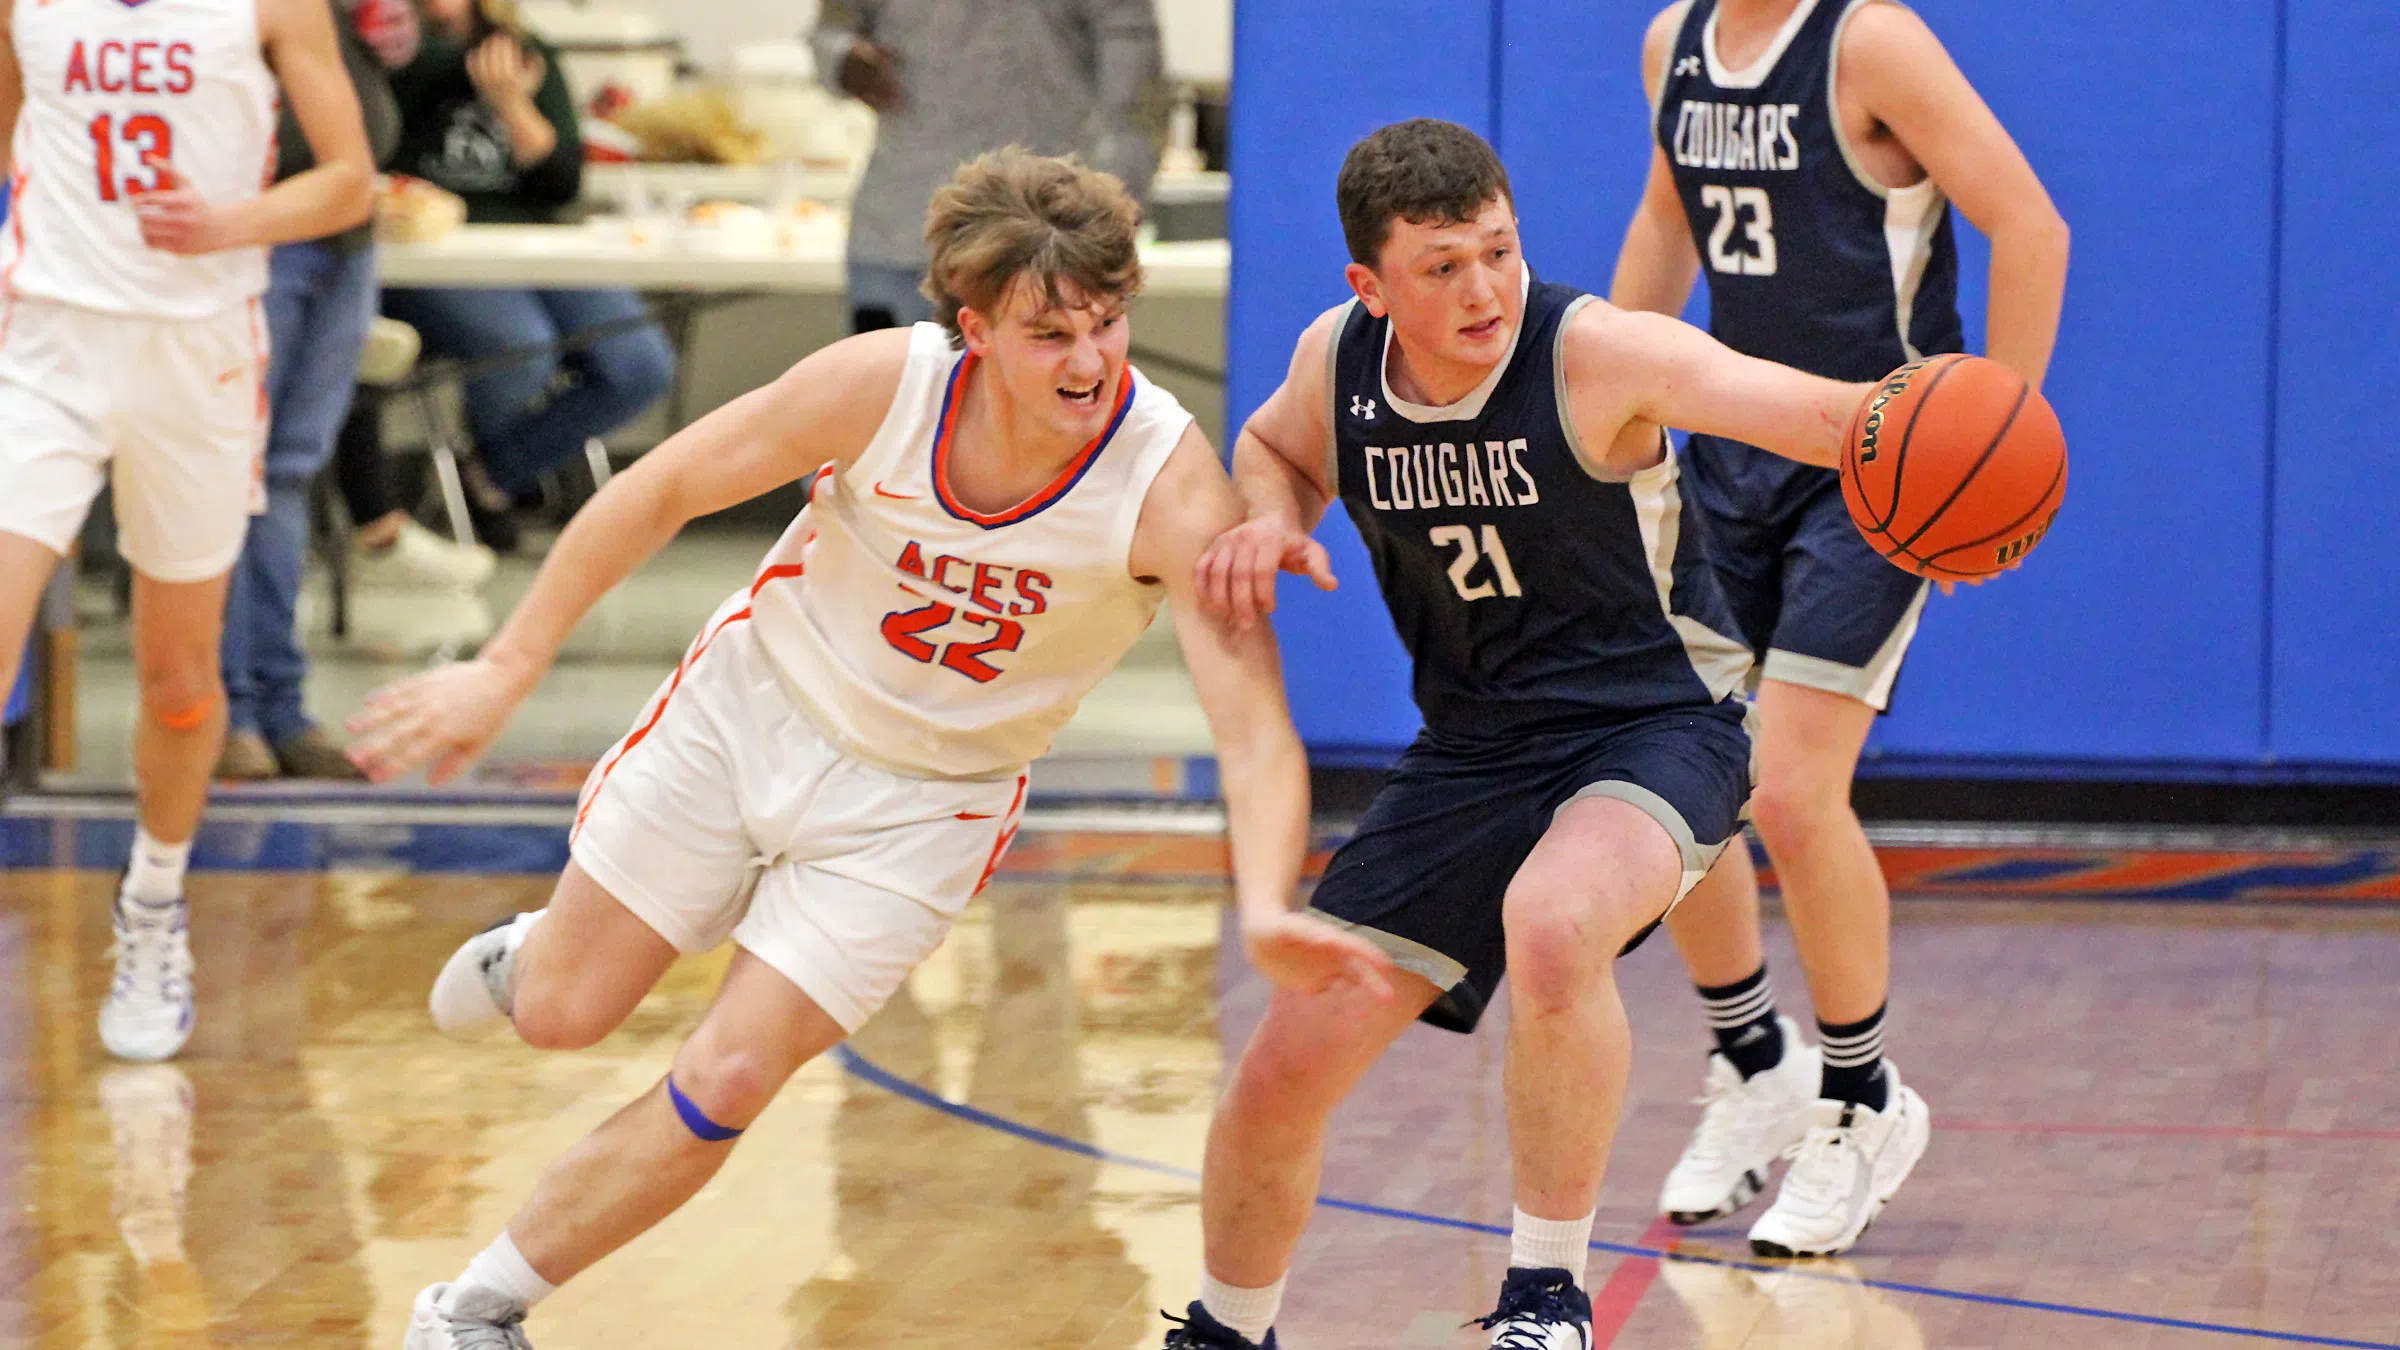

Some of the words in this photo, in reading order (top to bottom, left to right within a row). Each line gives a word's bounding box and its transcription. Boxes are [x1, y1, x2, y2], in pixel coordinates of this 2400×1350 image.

[64, 40, 194, 94] ACES
[89, 113, 177, 201] 13
[1674, 100, 1799, 170] COUGARS
[1701, 185, 1777, 276] 23
[1364, 438, 1540, 511] COUGARS
[896, 540, 1053, 617] ACES
[1429, 524, 1522, 601] 21
[880, 600, 1025, 684] 22
